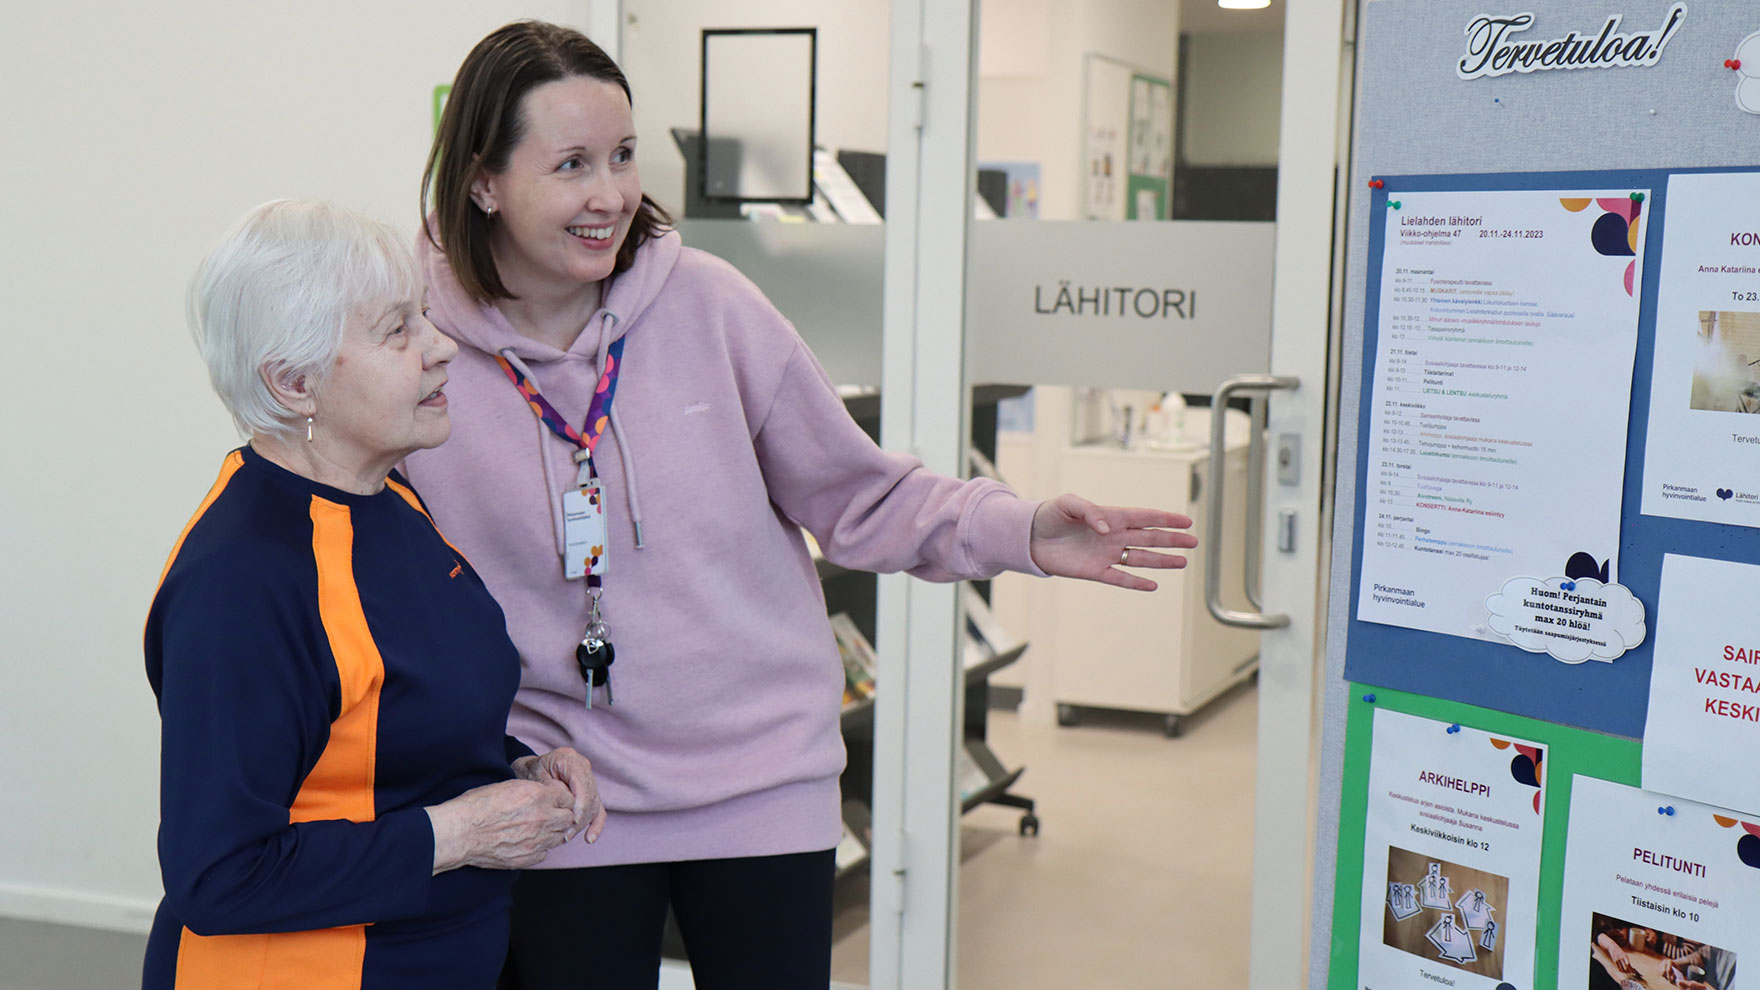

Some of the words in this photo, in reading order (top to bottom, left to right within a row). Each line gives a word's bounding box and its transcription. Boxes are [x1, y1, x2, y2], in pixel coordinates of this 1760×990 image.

[1460, 8, 1683, 73] Tervetuloa!
[1401, 216, 1446, 227] Lielahden
[1448, 216, 1483, 227] lähitori
[1400, 229, 1451, 239] Viikko-ohjelma
[1453, 229, 1461, 238] 47
[1479, 229, 1544, 239] 20.11.-24.11.2023
[1698, 265, 1719, 273] Anna
[1720, 265, 1756, 274] Katariina
[1035, 280, 1196, 319] LÄHITORI
[1732, 291, 1744, 301] To
[1662, 483, 1698, 493] Pirkanmaan
[1662, 491, 1708, 502] hyvinvointialue
[1373, 583, 1415, 596] Pirkanmaan
[1530, 587, 1560, 600] Huom!
[1563, 592, 1607, 608] Perjantain
[1372, 593, 1426, 608] hyvinvointialue
[1523, 599, 1603, 620] kuntotanssiryhmä
[1534, 615, 1554, 625] max
[1556, 617, 1567, 626] 20
[1569, 619, 1590, 631] hlöä!
[1418, 770, 1491, 798] ARKIHELPPI
[1457, 808, 1479, 819] Mukana
[1458, 819, 1483, 832] Susanna
[1410, 823, 1465, 845] Keskiviikkoisin
[1466, 838, 1478, 849] klo
[1480, 842, 1490, 852] 12
[1633, 847, 1707, 879] PELITUNTI
[1616, 873, 1644, 888] Pelataan
[1645, 883, 1671, 896] yhdessä
[1698, 897, 1719, 909] pelejä
[1631, 895, 1671, 915] Tiistaisin
[1672, 907, 1686, 919] klo
[1689, 912, 1700, 923] 10
[1420, 968, 1456, 987] Tervetuloa!
